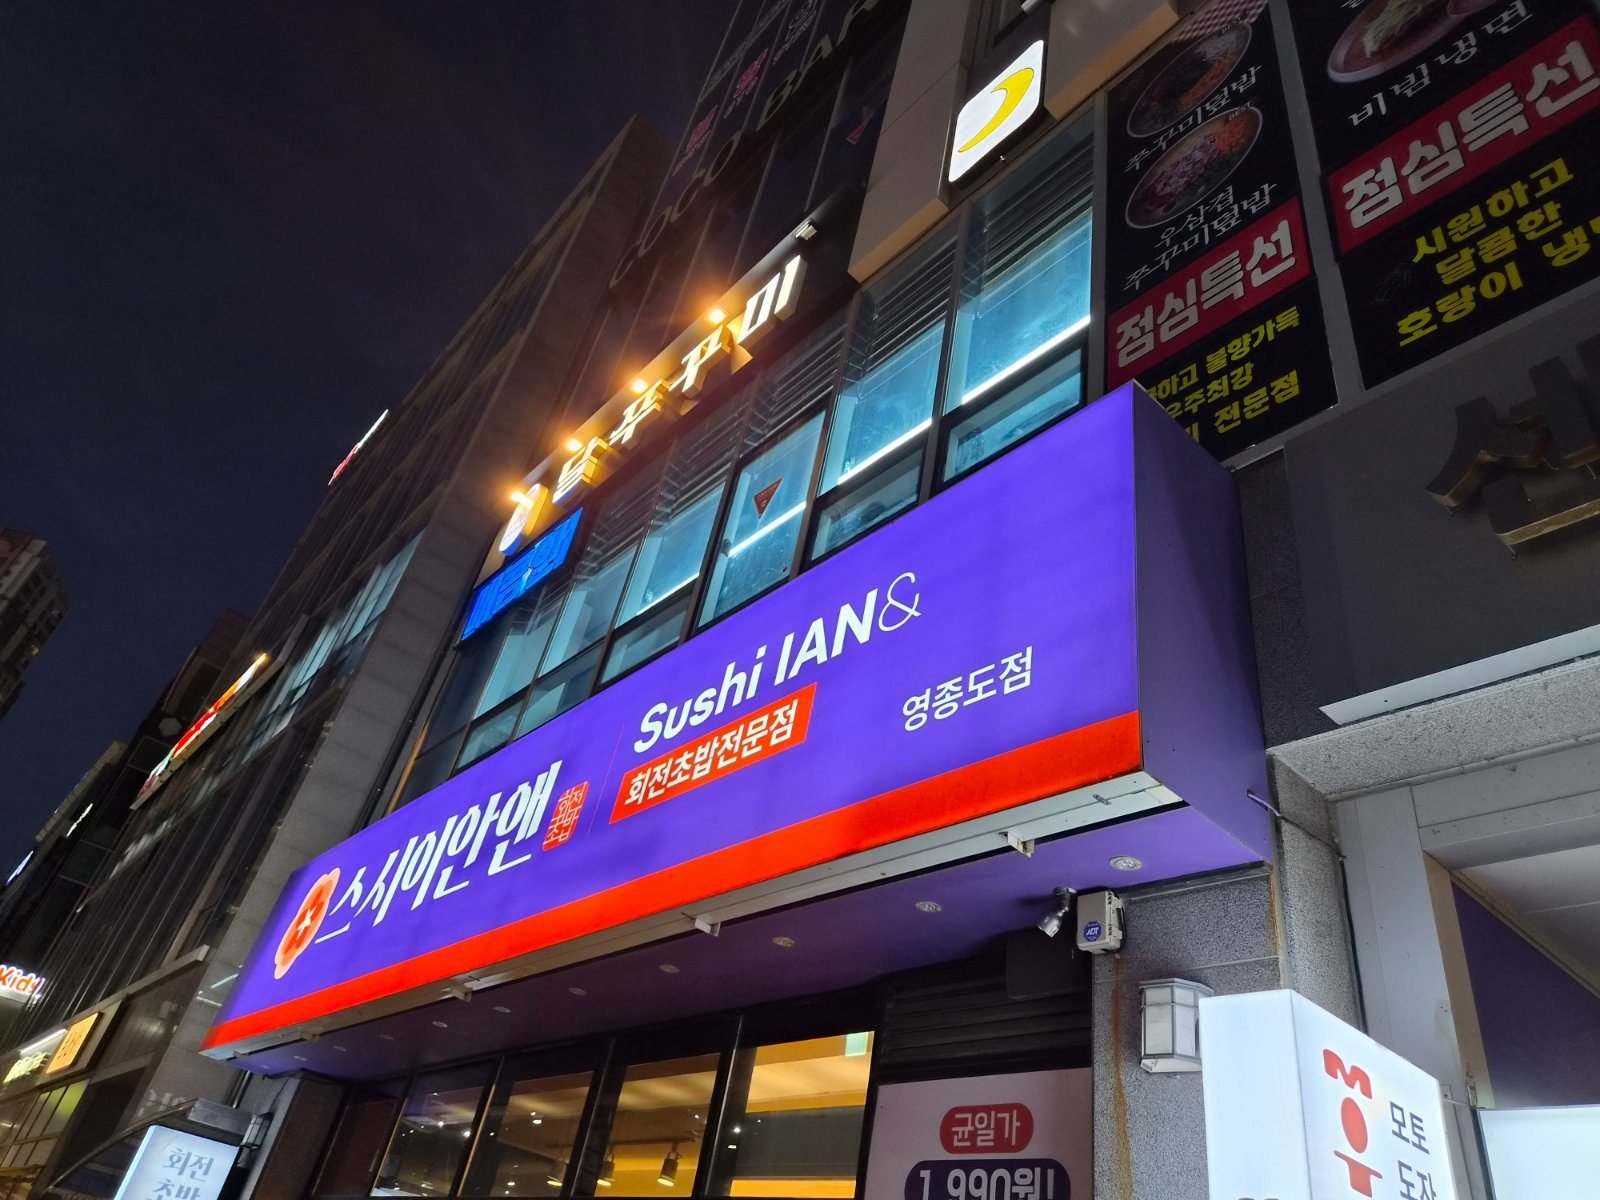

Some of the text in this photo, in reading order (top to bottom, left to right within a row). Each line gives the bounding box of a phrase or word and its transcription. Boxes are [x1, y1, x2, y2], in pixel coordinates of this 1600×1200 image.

[1348, 0, 1533, 126] 비빔냉면
[1342, 40, 1600, 229] 점심특선
[1154, 185, 1234, 247] 우삼겹
[1412, 157, 1574, 264] 시원하고
[1435, 201, 1563, 285] 달콤한
[1116, 220, 1297, 367] 점심특선
[1397, 215, 1600, 347] 호랑이 냉
[1205, 306, 1300, 374] 불향가득
[1213, 370, 1301, 434] 전문점
[634, 645, 767, 754] Sushi
[902, 646, 1033, 732] 영종도점
[624, 699, 799, 805] 회전초밥전문점
[315, 760, 563, 944] 스시이안앤
[1086, 926, 1100, 936] ADT
[162, 1147, 215, 1182] 회전
[951, 1110, 1021, 1147] 균일가
[1390, 1101, 1430, 1154] 모토
